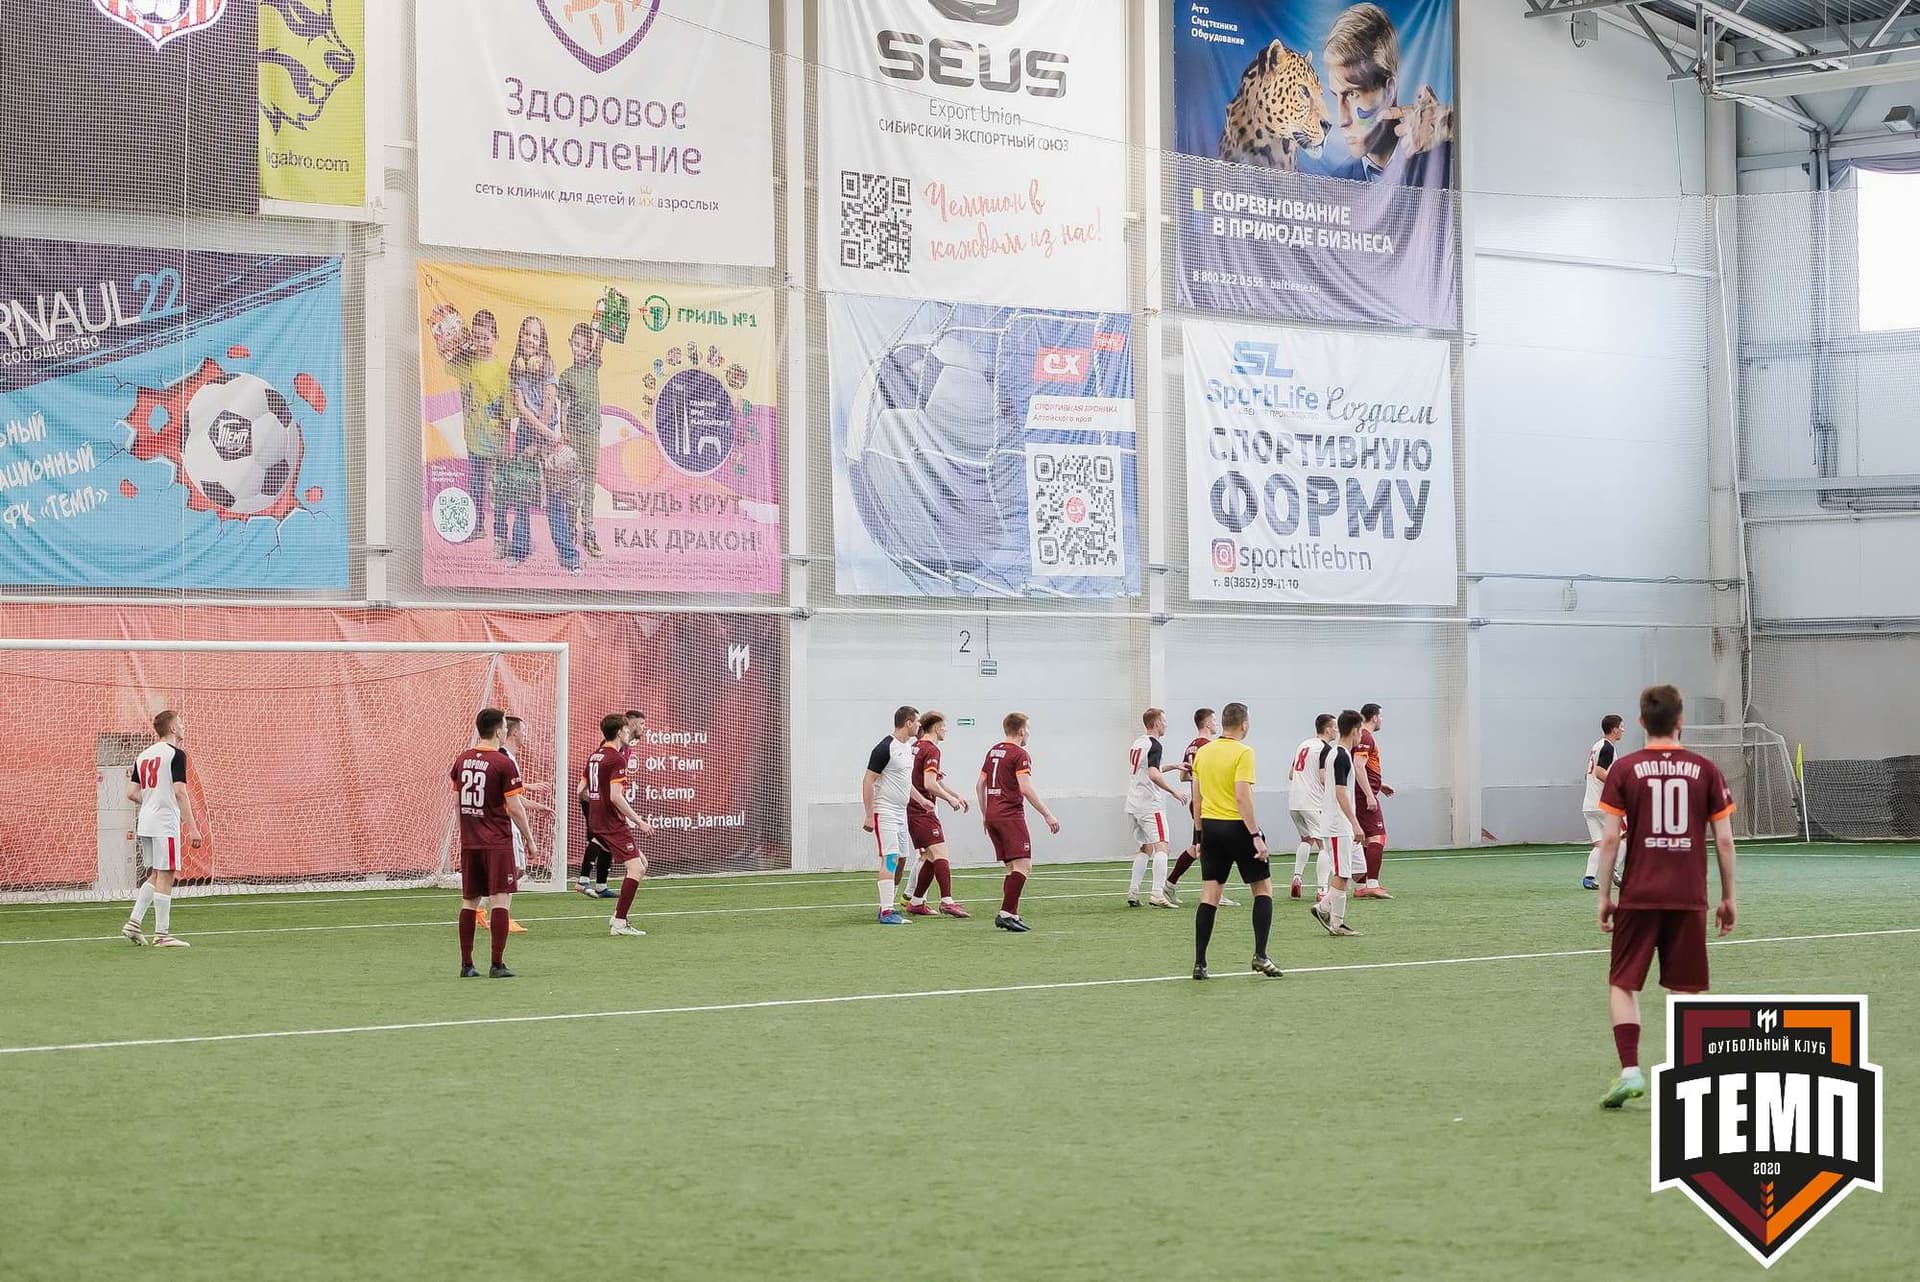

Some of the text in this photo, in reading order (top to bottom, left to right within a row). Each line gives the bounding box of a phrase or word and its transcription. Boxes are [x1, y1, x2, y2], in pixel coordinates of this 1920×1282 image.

[876, 29, 1070, 98] SEUS
[505, 77, 687, 130] Здоровое
[929, 98, 1021, 126] Export Union
[878, 118, 951, 140] СИБИРСКИЙ
[954, 128, 1035, 150] ЭКСПОРТНЫЙ
[266, 147, 349, 172] ligabro.com
[492, 130, 702, 175] поколение
[475, 182, 503, 195] сеть
[507, 185, 555, 201] клиник
[558, 190, 582, 203] для
[586, 191, 625, 206] детей
[628, 196, 635, 206] и
[657, 196, 719, 212] взрослых
[924, 182, 1026, 222] Чемпион
[1213, 191, 1351, 225] СОРЕВНОВАНИЕ
[931, 206, 1103, 261] каждом из нас!
[1213, 218, 1395, 254] В ПРИРОДЕ БИЗНЕСА
[677, 308, 757, 327] ГРИЛЬ №1
[1207, 379, 1319, 410] SportLife
[1327, 385, 1438, 433] Создаем
[1209, 427, 1433, 472] СПОРТИВНУЮ
[4, 486, 109, 529] ФК «ТЕМП»
[612, 490, 682, 517] БУДЬ
[1210, 470, 1431, 540] ФОРМУ
[614, 527, 761, 554] КАК ДРАКОН!
[1239, 543, 1372, 574] sportlifebrn
[959, 630, 971, 653] 2
[646, 730, 708, 747] fctemp.ru
[140, 756, 161, 790] 18
[645, 756, 704, 771] ФК Темп
[992, 758, 999, 788] 7
[1295, 747, 1309, 772] 8
[1634, 760, 1701, 780] АПАЛЬКИН
[461, 769, 486, 808] 23
[645, 785, 695, 802] fc.temp
[647, 811, 745, 831] fctemp_barnaul
[1647, 778, 1688, 835] 10
[1644, 837, 1692, 848] SEUS
